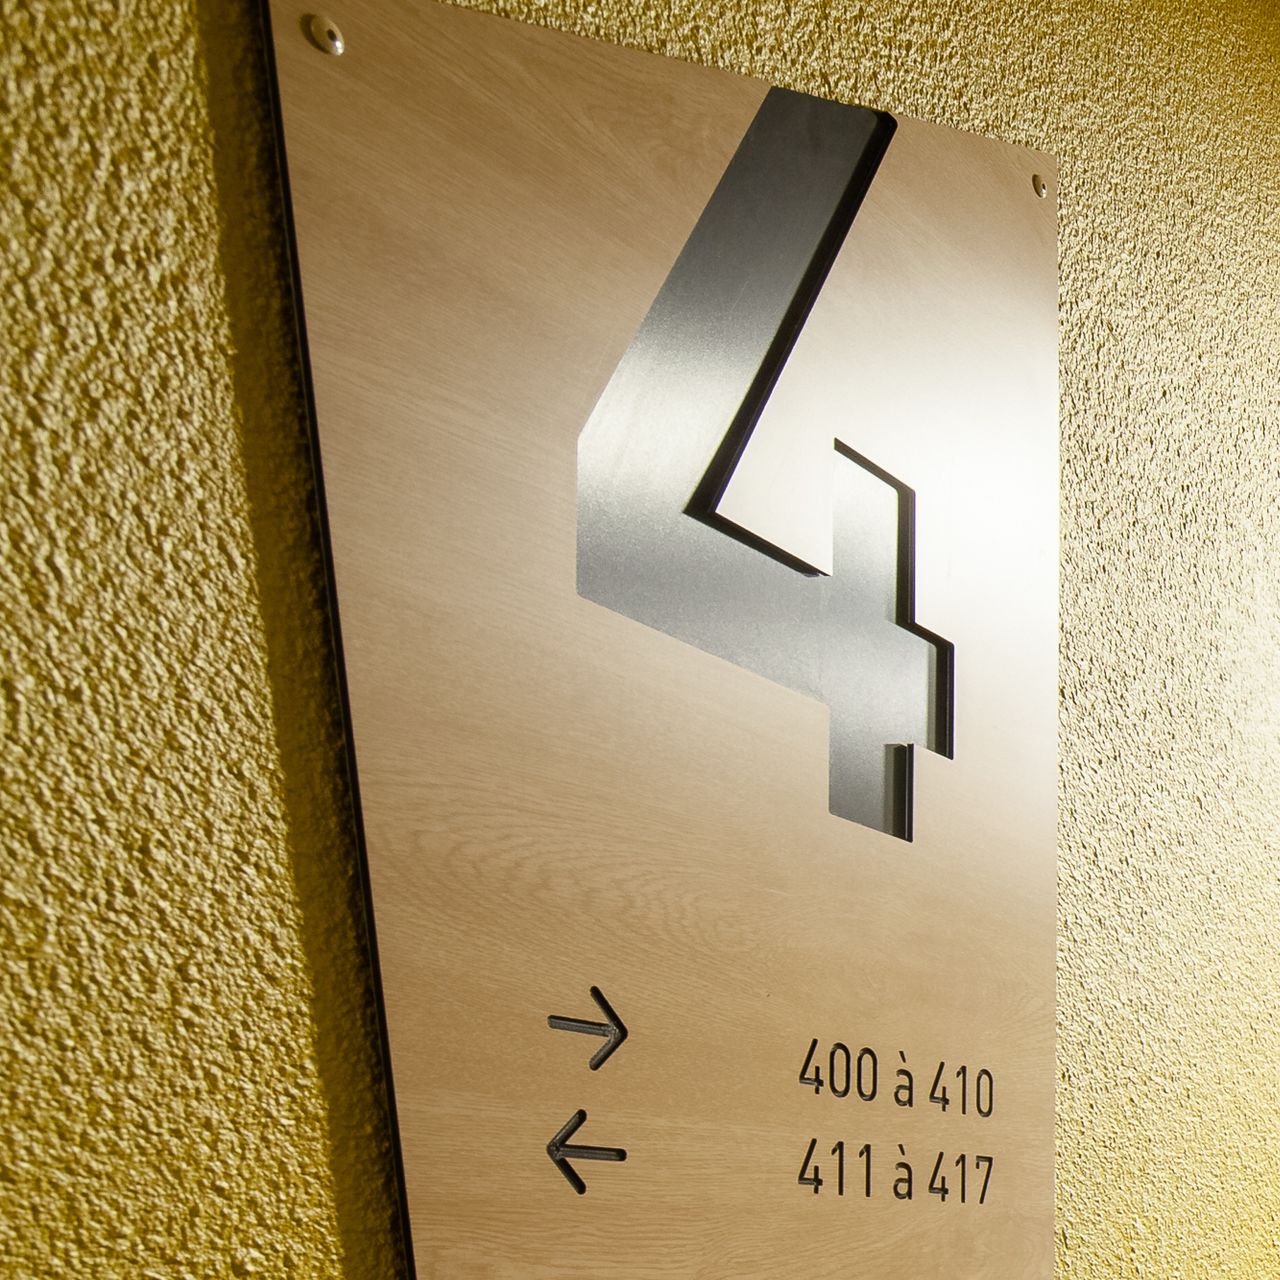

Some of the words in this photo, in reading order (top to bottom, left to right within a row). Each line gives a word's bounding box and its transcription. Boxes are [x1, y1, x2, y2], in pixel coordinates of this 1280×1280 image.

[576, 85, 954, 843] 4
[799, 1038, 878, 1102] 400
[893, 1050, 914, 1107] à
[928, 1061, 994, 1118] 410
[798, 1138, 873, 1198] 411
[893, 1144, 914, 1200] à
[928, 1151, 994, 1204] 417
